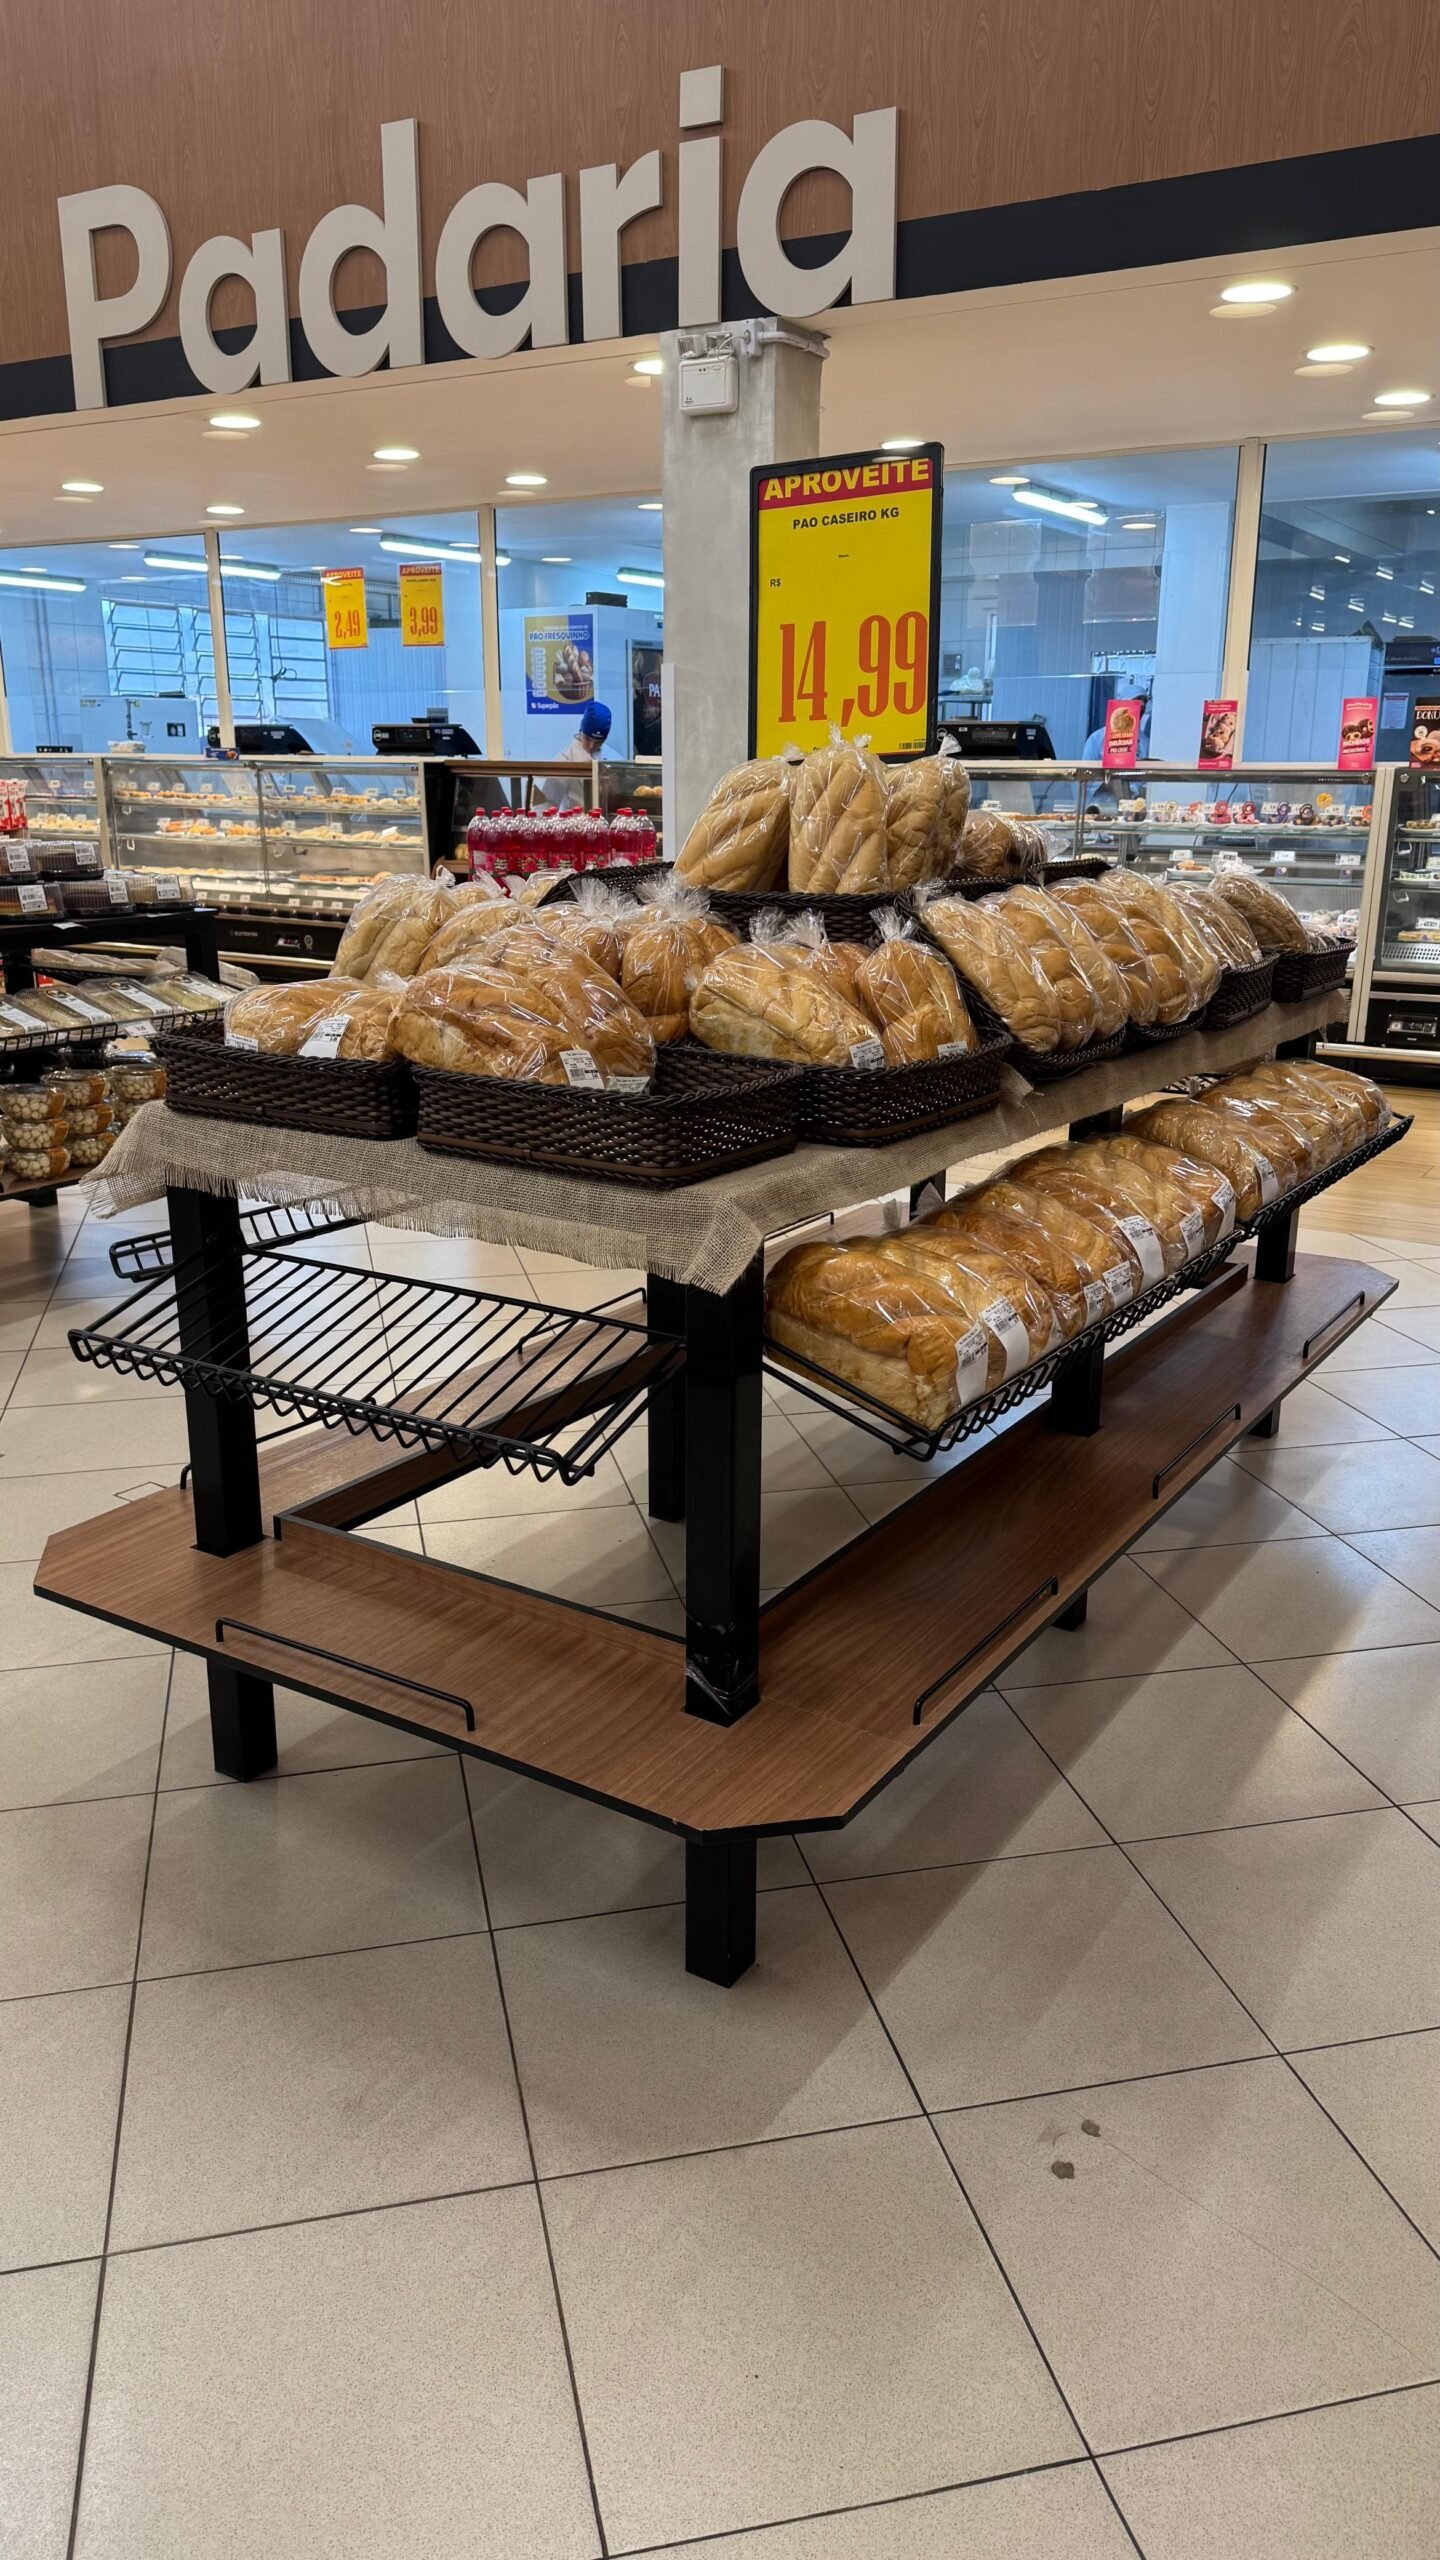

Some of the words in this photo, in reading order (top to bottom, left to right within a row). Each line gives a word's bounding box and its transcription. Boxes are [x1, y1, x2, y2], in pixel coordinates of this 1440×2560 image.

[57, 65, 899, 410] Padaria
[764, 458, 929, 500] APROVEITE
[793, 517, 817, 529] PAO
[822, 510, 877, 526] CASEIRO
[881, 507, 899, 518] KG
[401, 566, 441, 574] APROVEITE
[770, 578, 781, 587] R$
[335, 610, 361, 639] 2,49
[410, 606, 438, 637] 3,99
[544, 631, 589, 640] FRESQUINHO
[778, 611, 928, 727] 14,99
